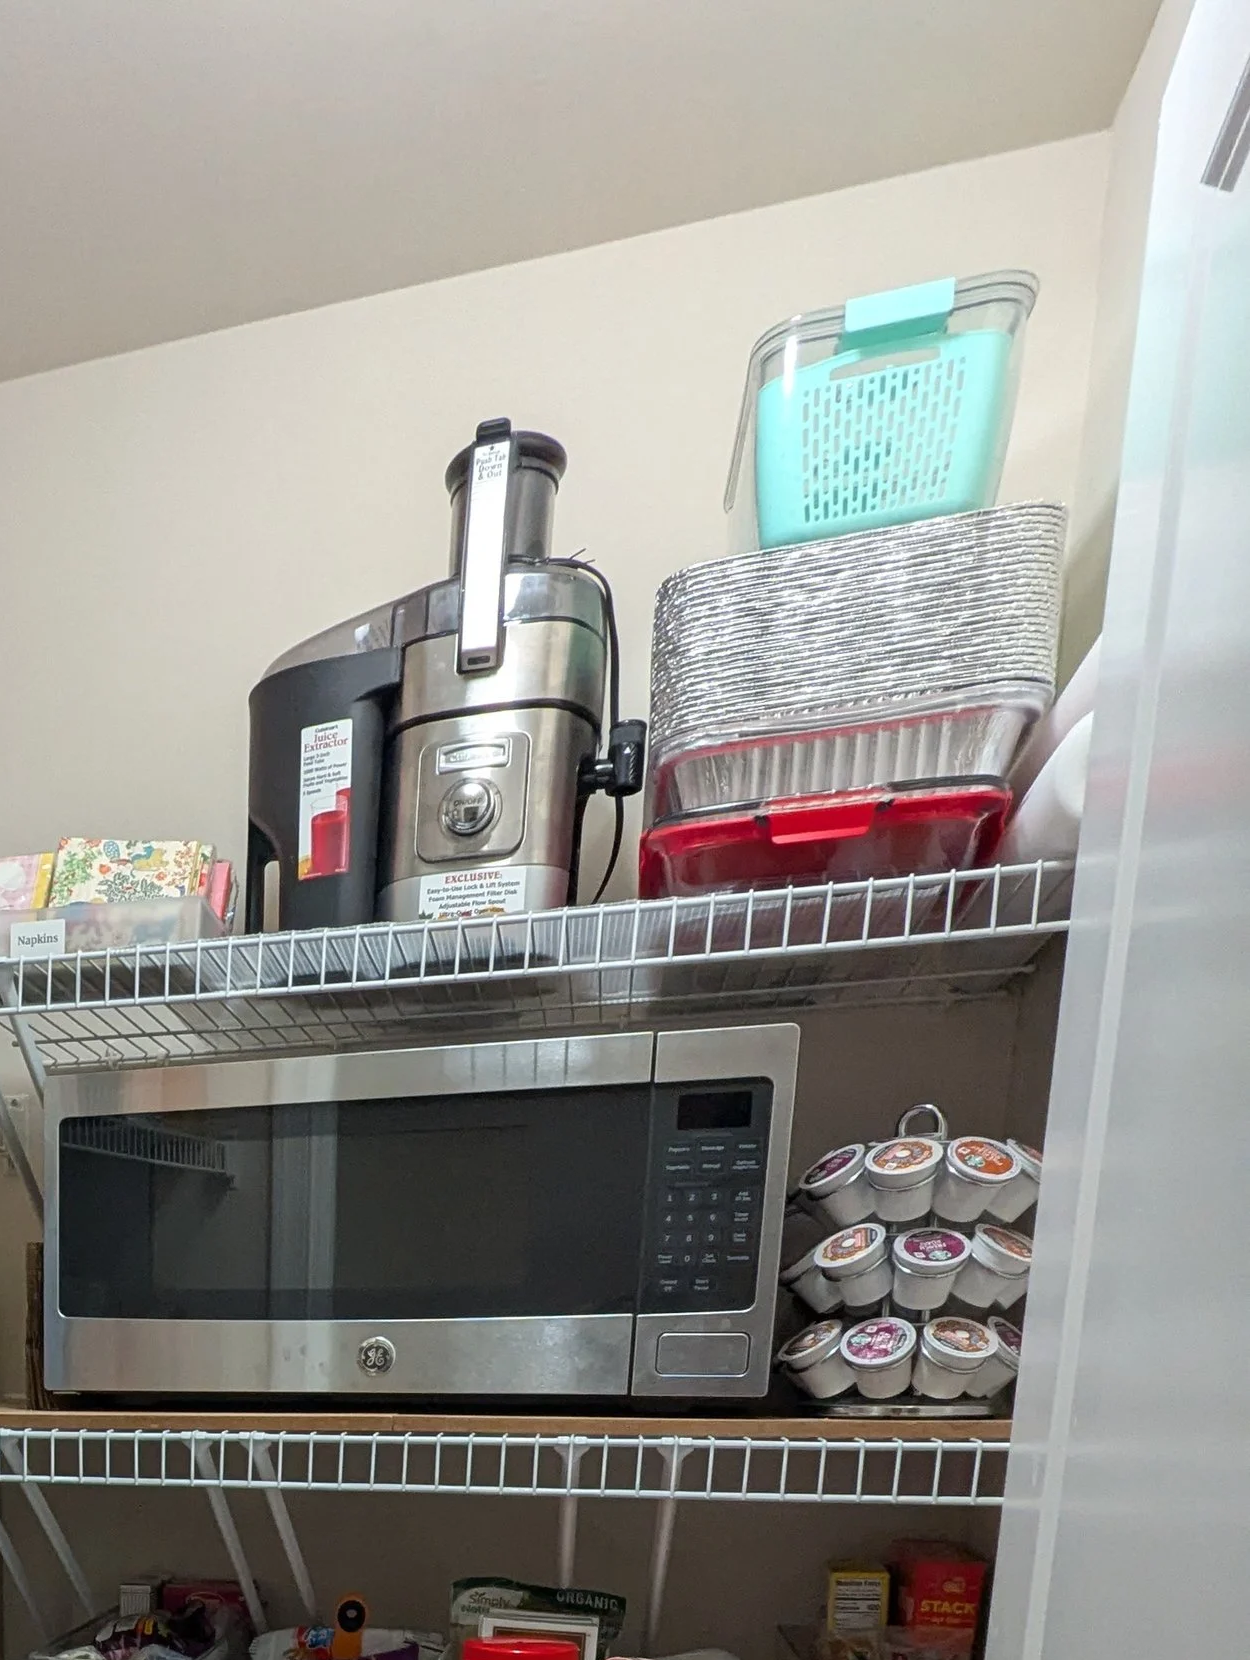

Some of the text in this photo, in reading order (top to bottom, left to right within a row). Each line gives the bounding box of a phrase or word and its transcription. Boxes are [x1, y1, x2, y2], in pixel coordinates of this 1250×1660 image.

[314, 731, 338, 744] Juice
[304, 738, 348, 753] Extractor
[464, 883, 478, 891] Lock
[497, 880, 520, 889] System
[438, 901, 471, 910] Adjustable
[18, 932, 59, 947] Napkins
[556, 1592, 619, 1610] ORGANIC
